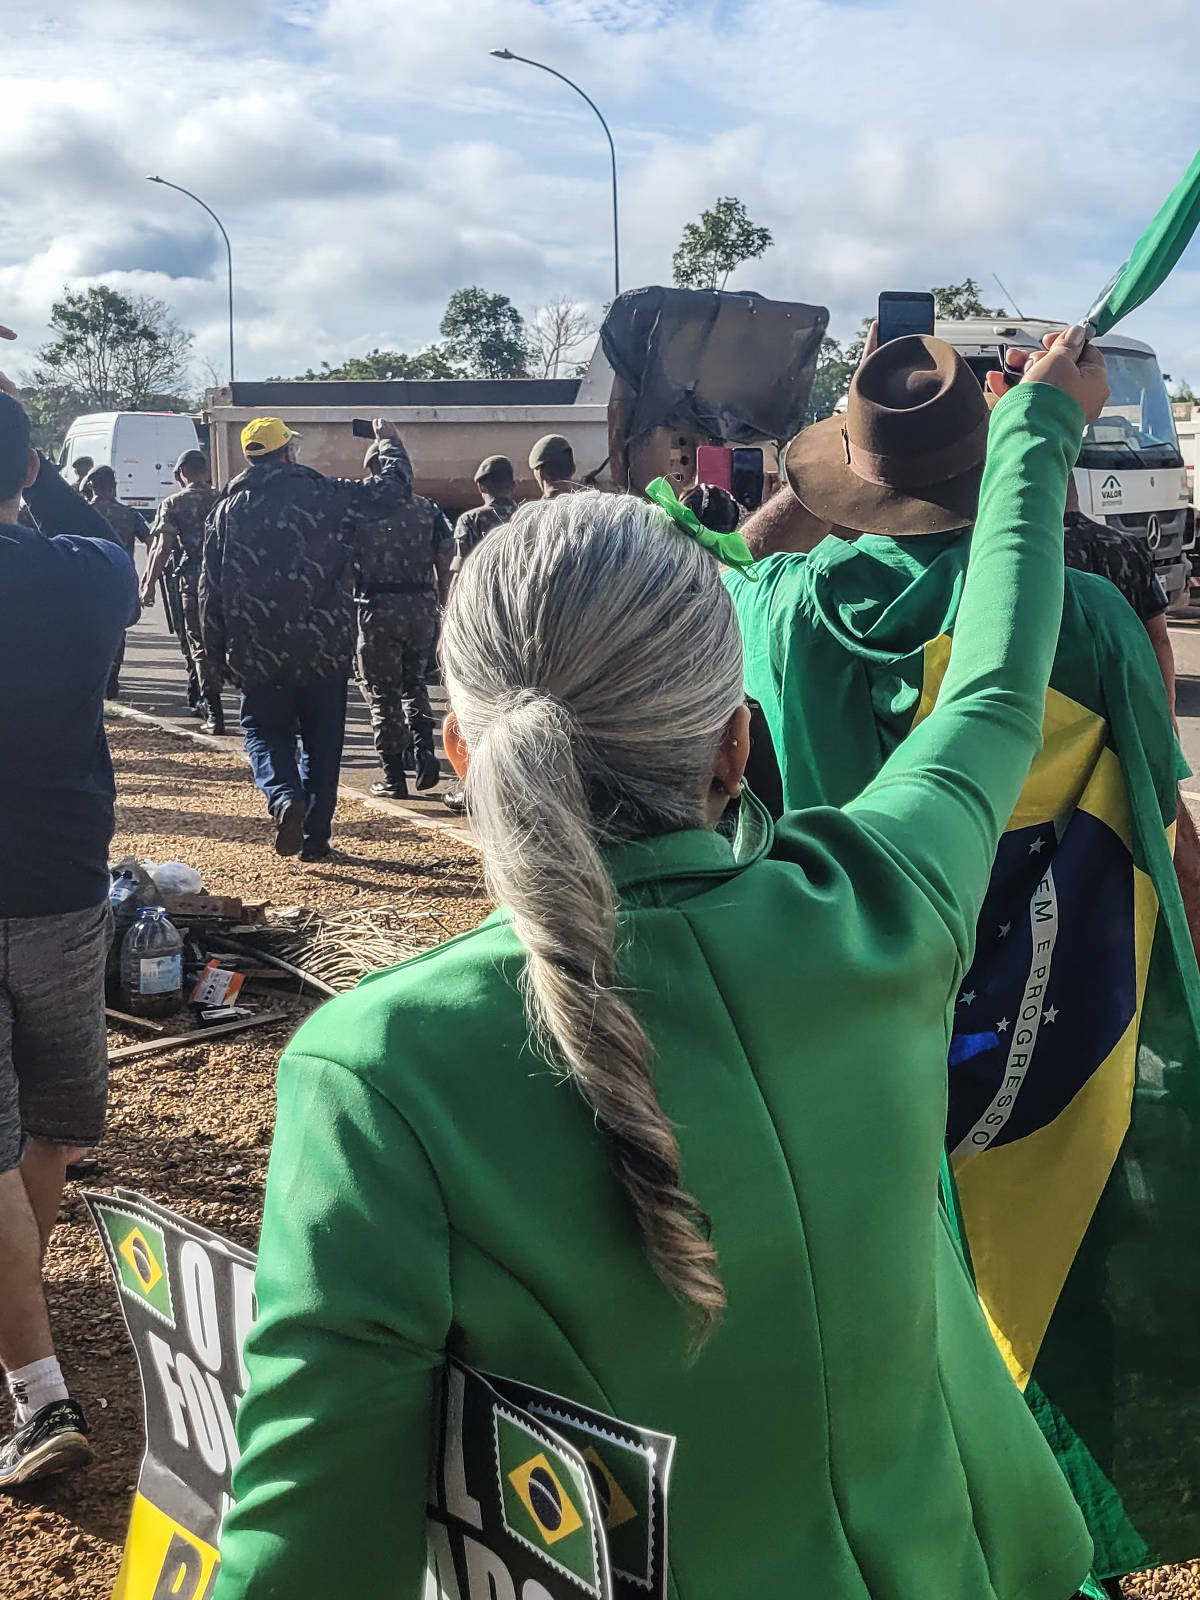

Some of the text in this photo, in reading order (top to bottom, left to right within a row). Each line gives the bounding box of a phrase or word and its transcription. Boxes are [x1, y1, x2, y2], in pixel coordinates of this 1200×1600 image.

[1101, 490, 1122, 499] VALOR
[1037, 939, 1050, 954] E
[971, 965, 1047, 1145] PROGRESSO
[181, 1240, 222, 1372] O
